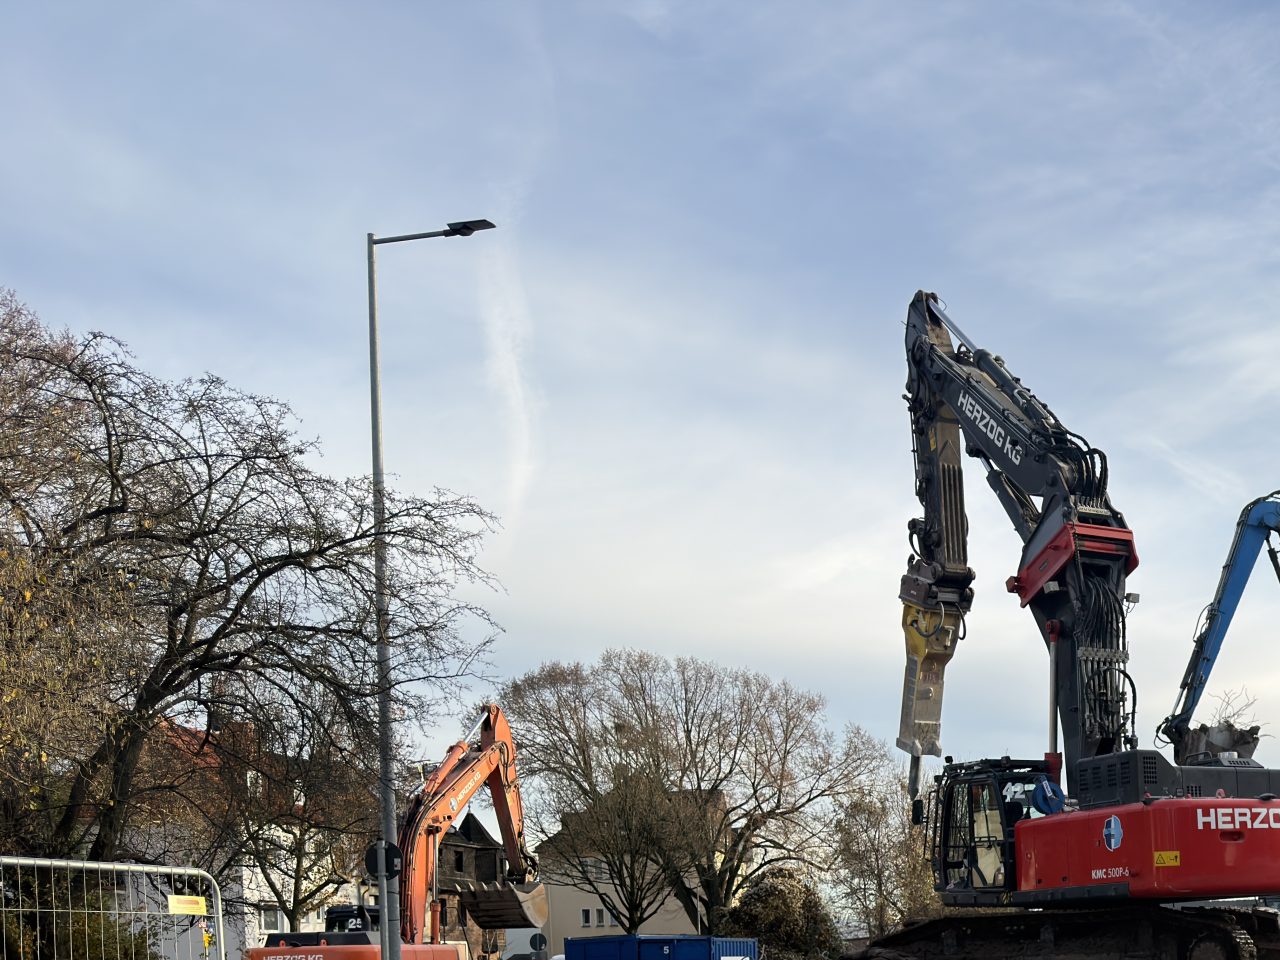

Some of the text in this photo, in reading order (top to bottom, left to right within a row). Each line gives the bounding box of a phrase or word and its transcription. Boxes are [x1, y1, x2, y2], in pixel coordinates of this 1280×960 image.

[957, 389, 1023, 466] HERZOG KG
[1002, 782, 1026, 803] 42
[663, 946, 670, 954] 5
